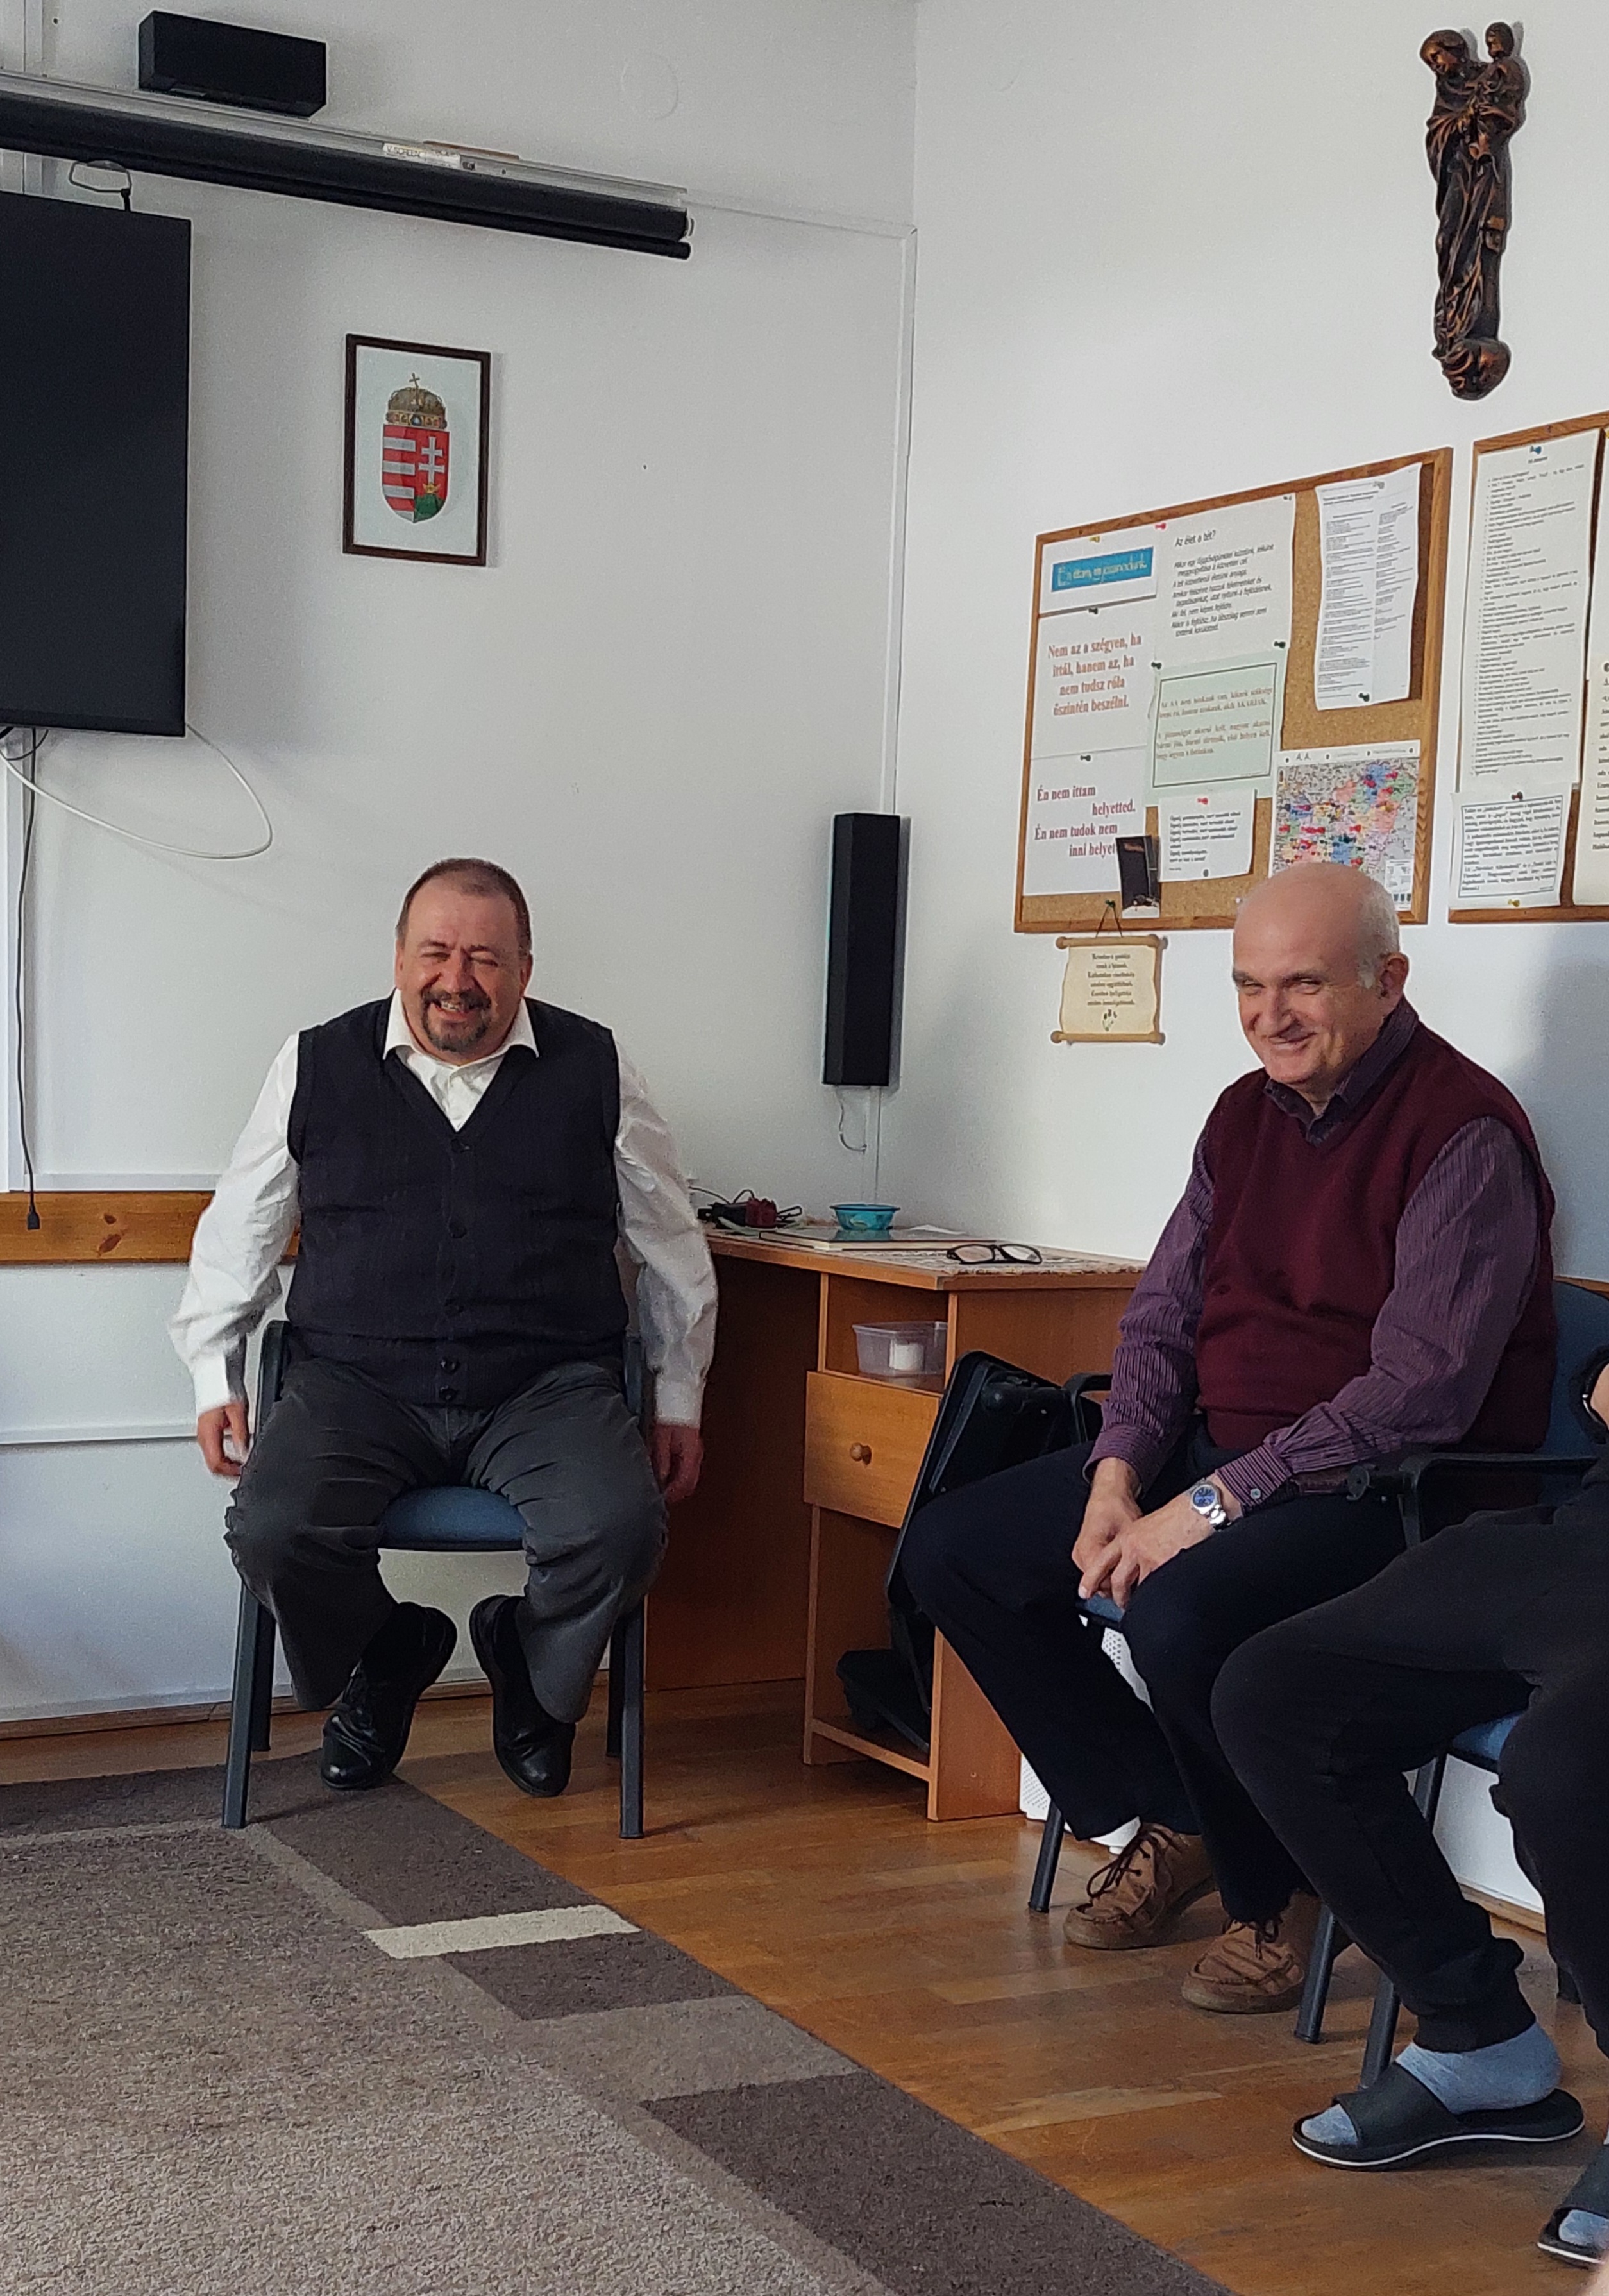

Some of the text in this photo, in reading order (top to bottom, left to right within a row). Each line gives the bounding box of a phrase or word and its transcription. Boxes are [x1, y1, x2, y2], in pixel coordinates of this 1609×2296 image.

[1048, 631, 1141, 659] Nem az a szégyen, ha
[1053, 655, 1134, 677] ittál, hanem az, ha
[1059, 675, 1125, 696] nem tudsz róla
[1053, 695, 1129, 716] őszintén beszélni.
[1037, 784, 1095, 801] Én nem ittam
[1092, 798, 1135, 818] helyetted.
[1034, 823, 1117, 840] Én nem tudok nem
[1069, 841, 1115, 858] inni helyet
